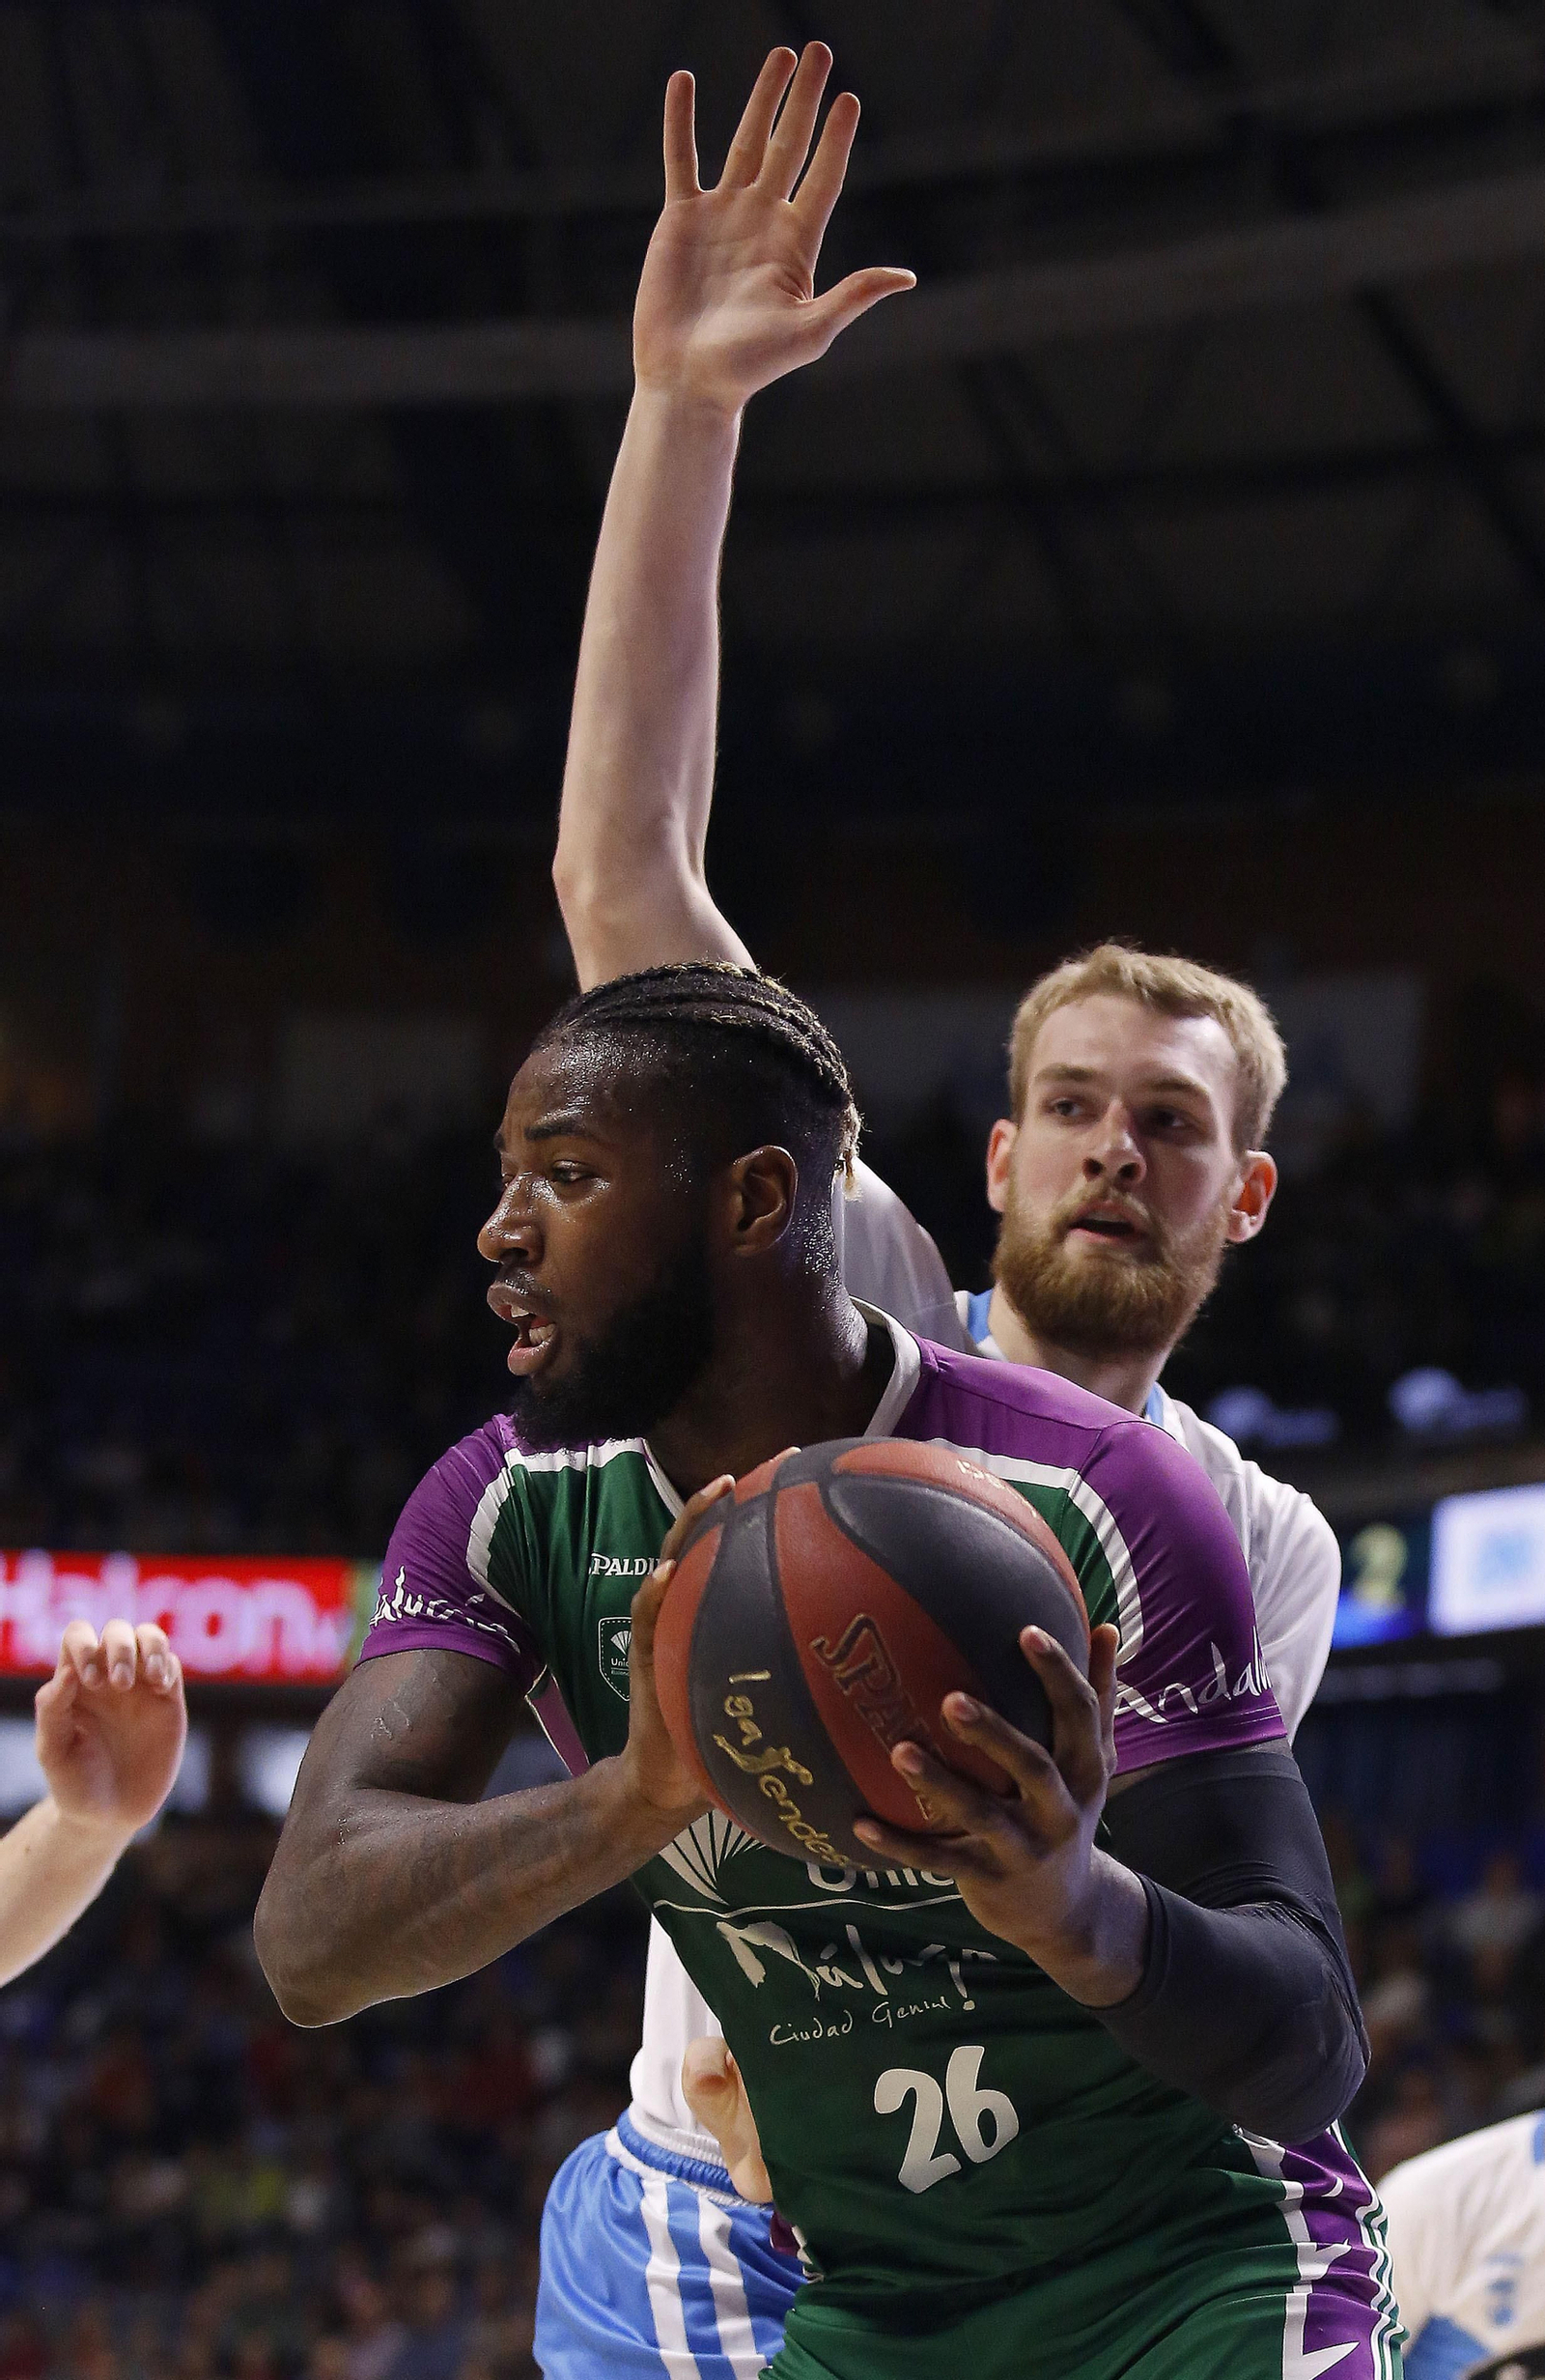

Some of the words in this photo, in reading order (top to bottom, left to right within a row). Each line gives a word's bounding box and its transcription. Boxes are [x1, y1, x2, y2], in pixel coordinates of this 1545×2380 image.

[589, 1553, 660, 1575] PALDI
[1114, 1626, 1273, 1723] Andal
[770, 2010, 853, 2046] Ciudad
[872, 1996, 951, 2027] Genial
[874, 2046, 1019, 2194] 26
